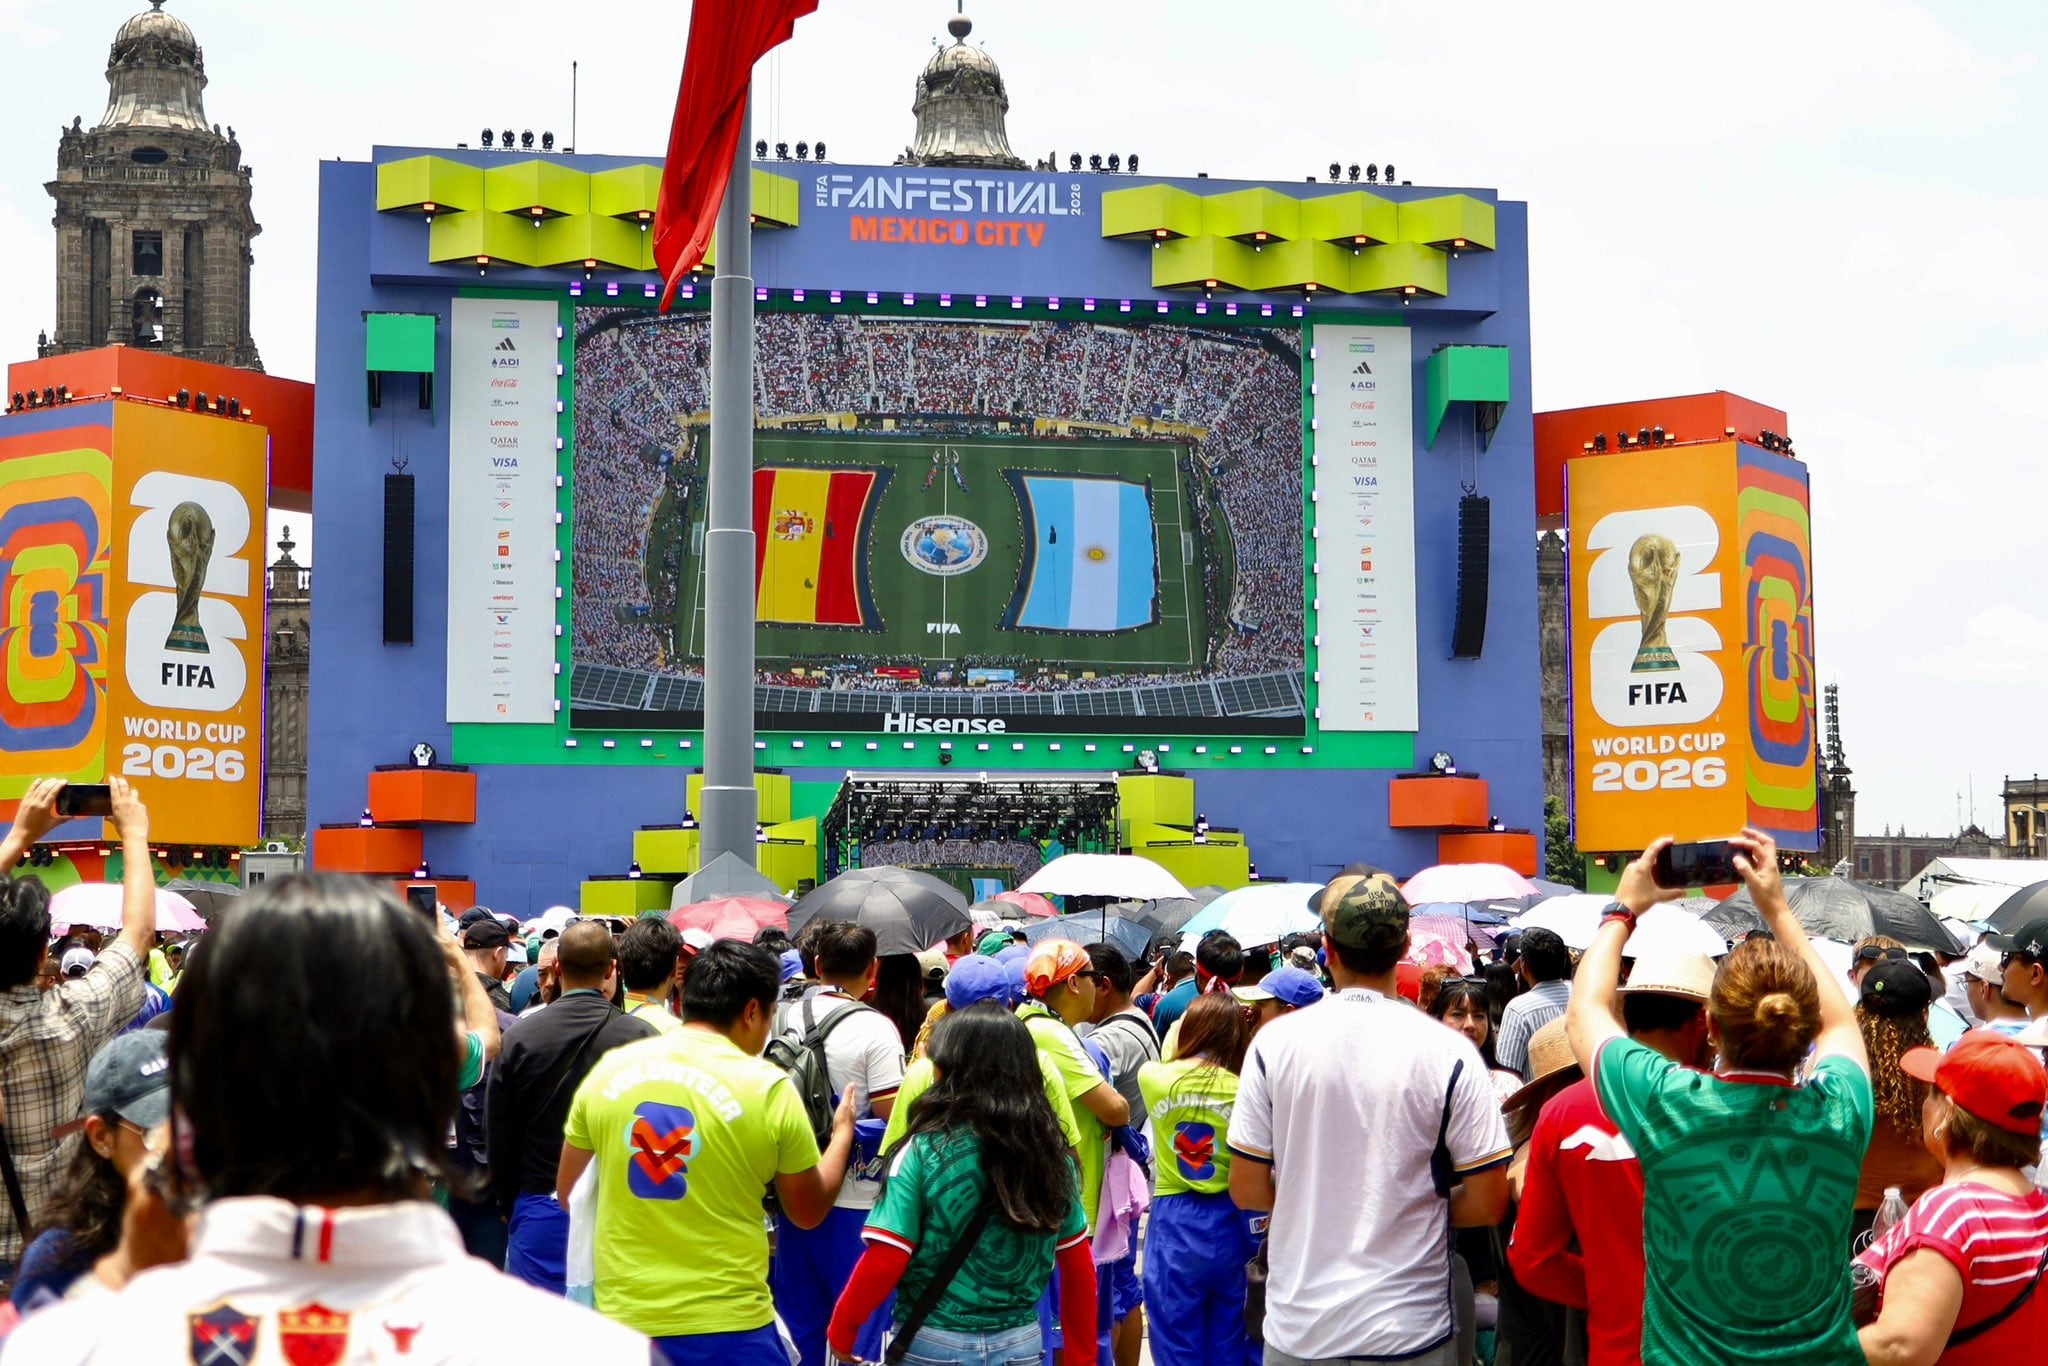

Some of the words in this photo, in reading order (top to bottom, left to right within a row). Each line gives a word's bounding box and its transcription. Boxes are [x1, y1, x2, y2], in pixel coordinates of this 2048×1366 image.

[816, 175, 828, 207] FIFA
[1070, 184, 1081, 216] 2026
[850, 216, 970, 245] MEXICO
[976, 219, 1046, 247] CITY
[499, 358, 519, 366] ADI
[492, 458, 518, 467] VISA
[1354, 477, 1377, 486] VISA
[927, 623, 961, 633] FIFA
[162, 662, 215, 689] FIFA
[1628, 682, 1687, 706] FIFA
[124, 716, 201, 741] WORLD
[205, 723, 246, 744] CUP
[884, 712, 1006, 733] Hisense
[1592, 735, 1676, 756] WORLD
[1678, 732, 1726, 752] CUP
[122, 743, 245, 782] 2026
[1592, 756, 1727, 792] 2026
[1356, 900, 1376, 913] NEW
[1380, 900, 1398, 909] YORK
[1368, 891, 1386, 900] USA
[602, 1062, 743, 1122] VOLUNTEER
